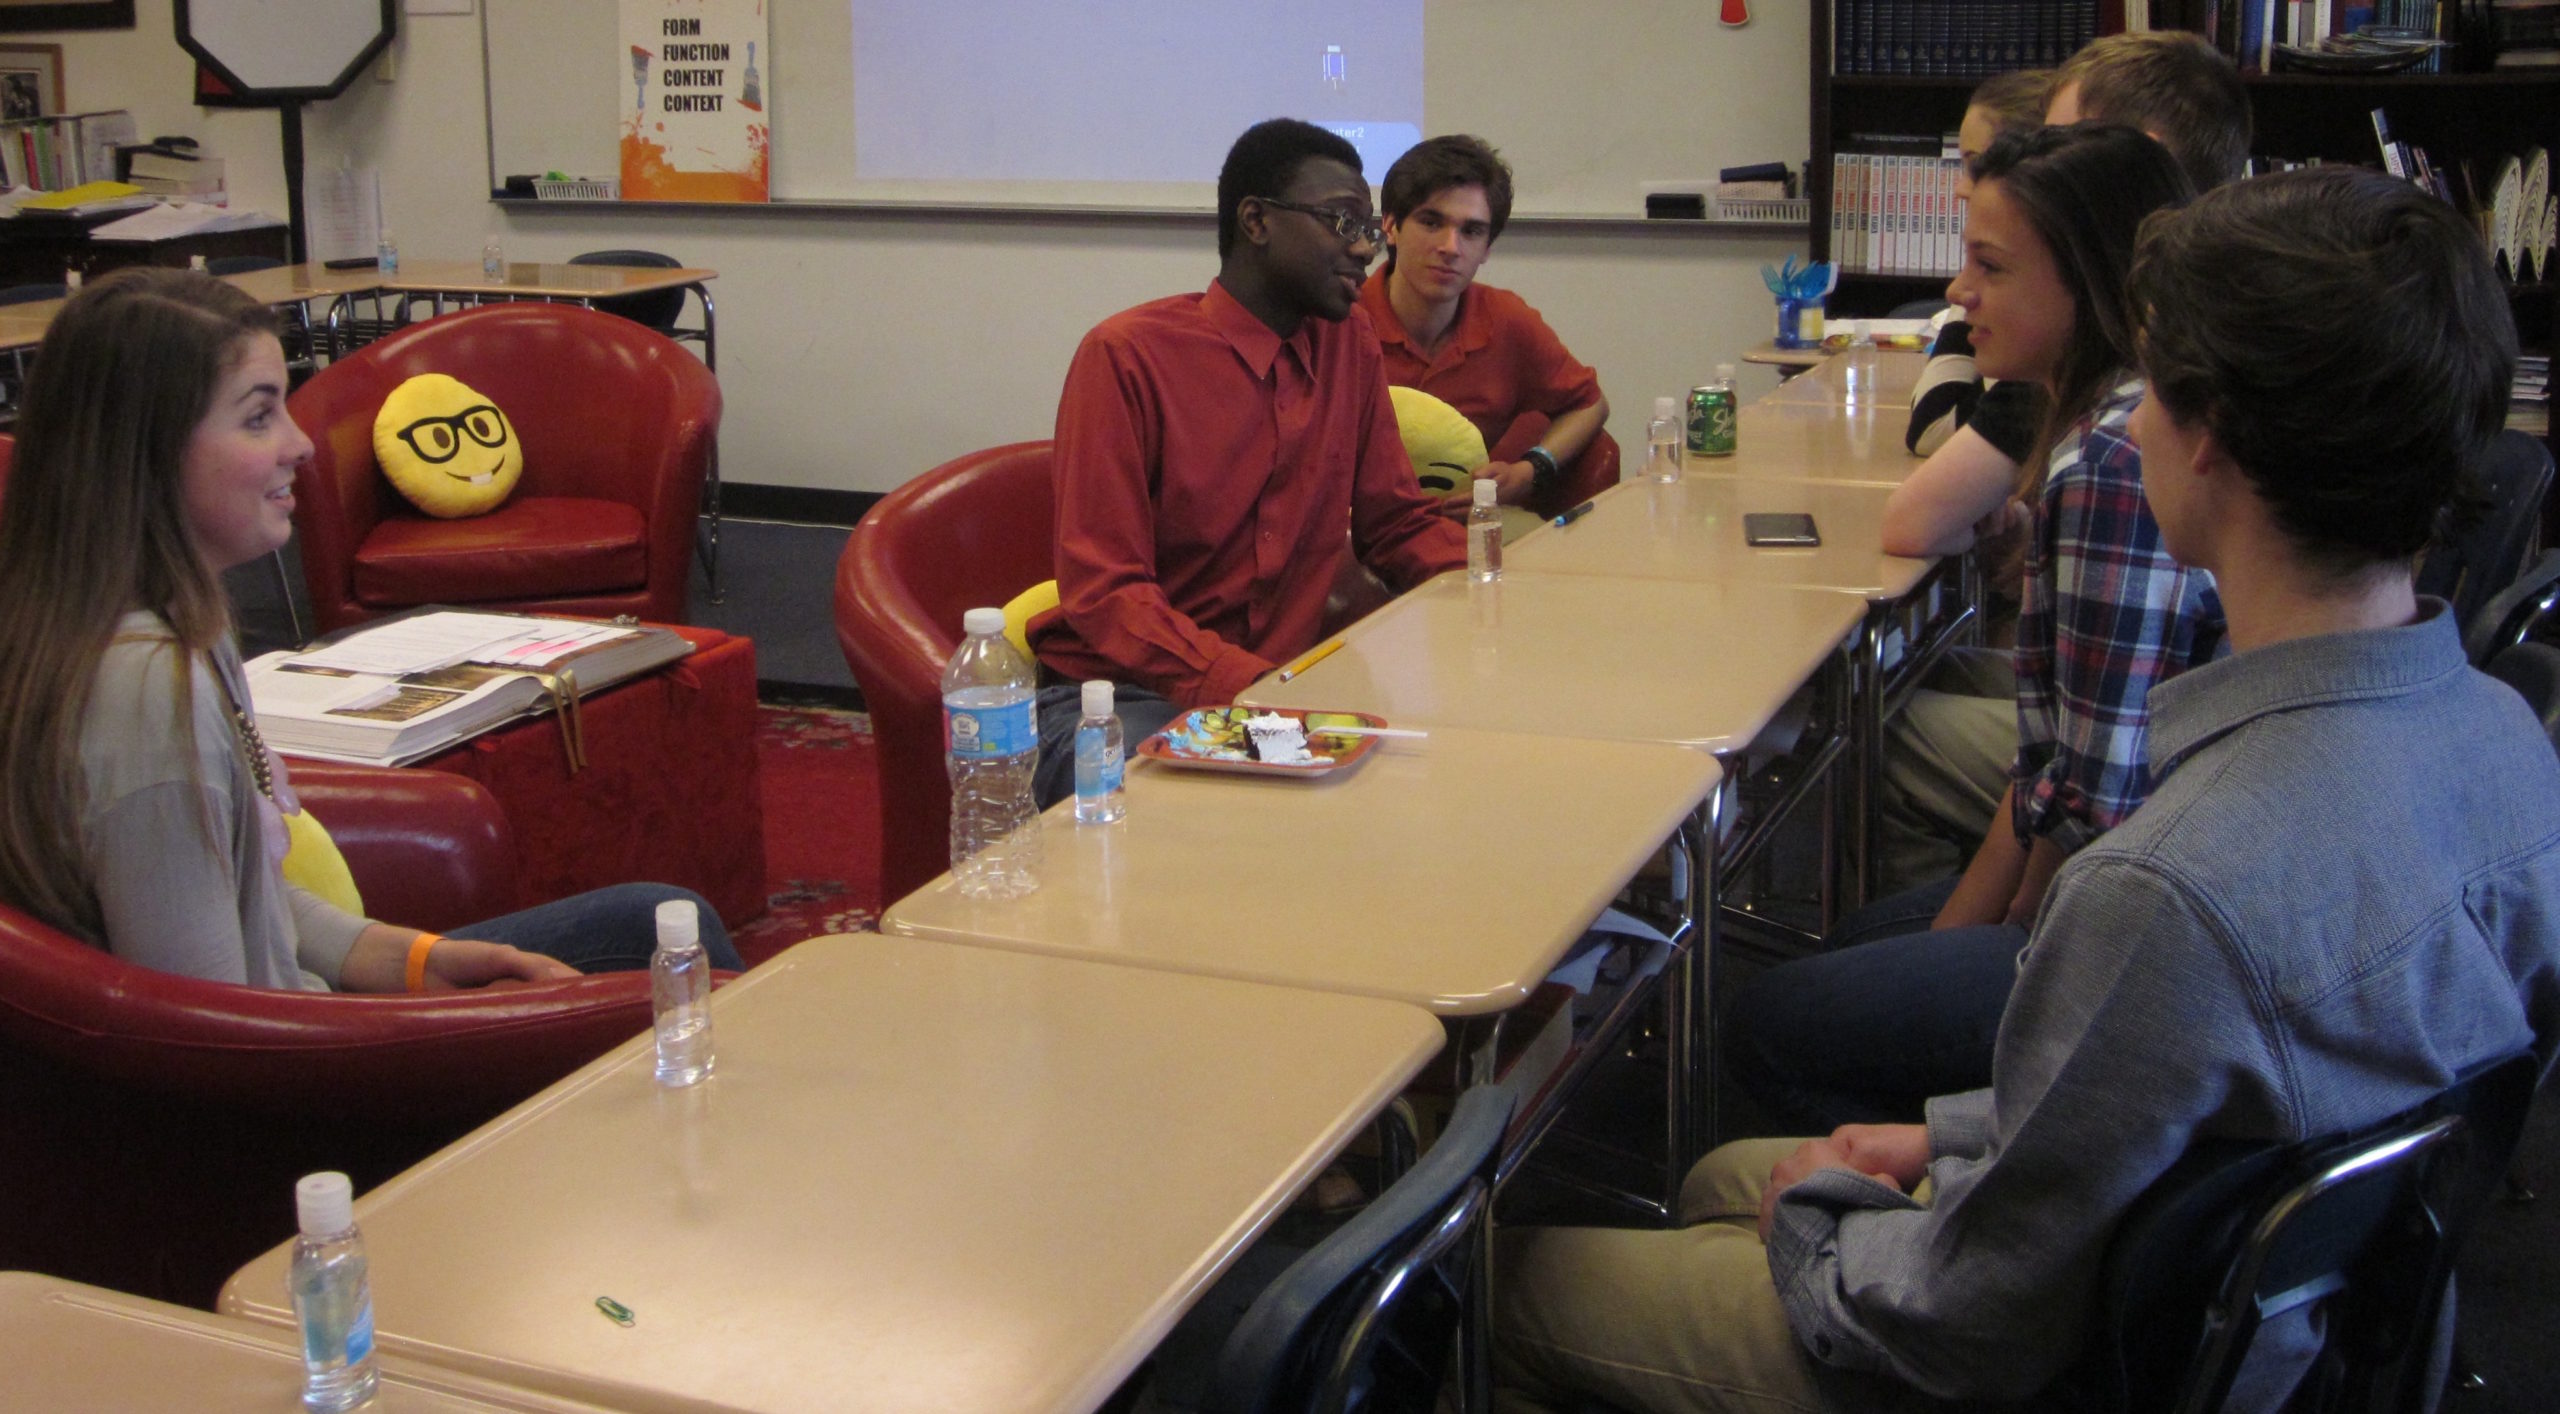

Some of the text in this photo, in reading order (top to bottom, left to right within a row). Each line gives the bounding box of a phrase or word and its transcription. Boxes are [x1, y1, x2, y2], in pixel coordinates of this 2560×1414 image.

[663, 19, 700, 36] FORM
[663, 44, 730, 61] FUNCTION
[664, 70, 724, 86] CONTENT
[664, 95, 723, 112] CONTEXT
